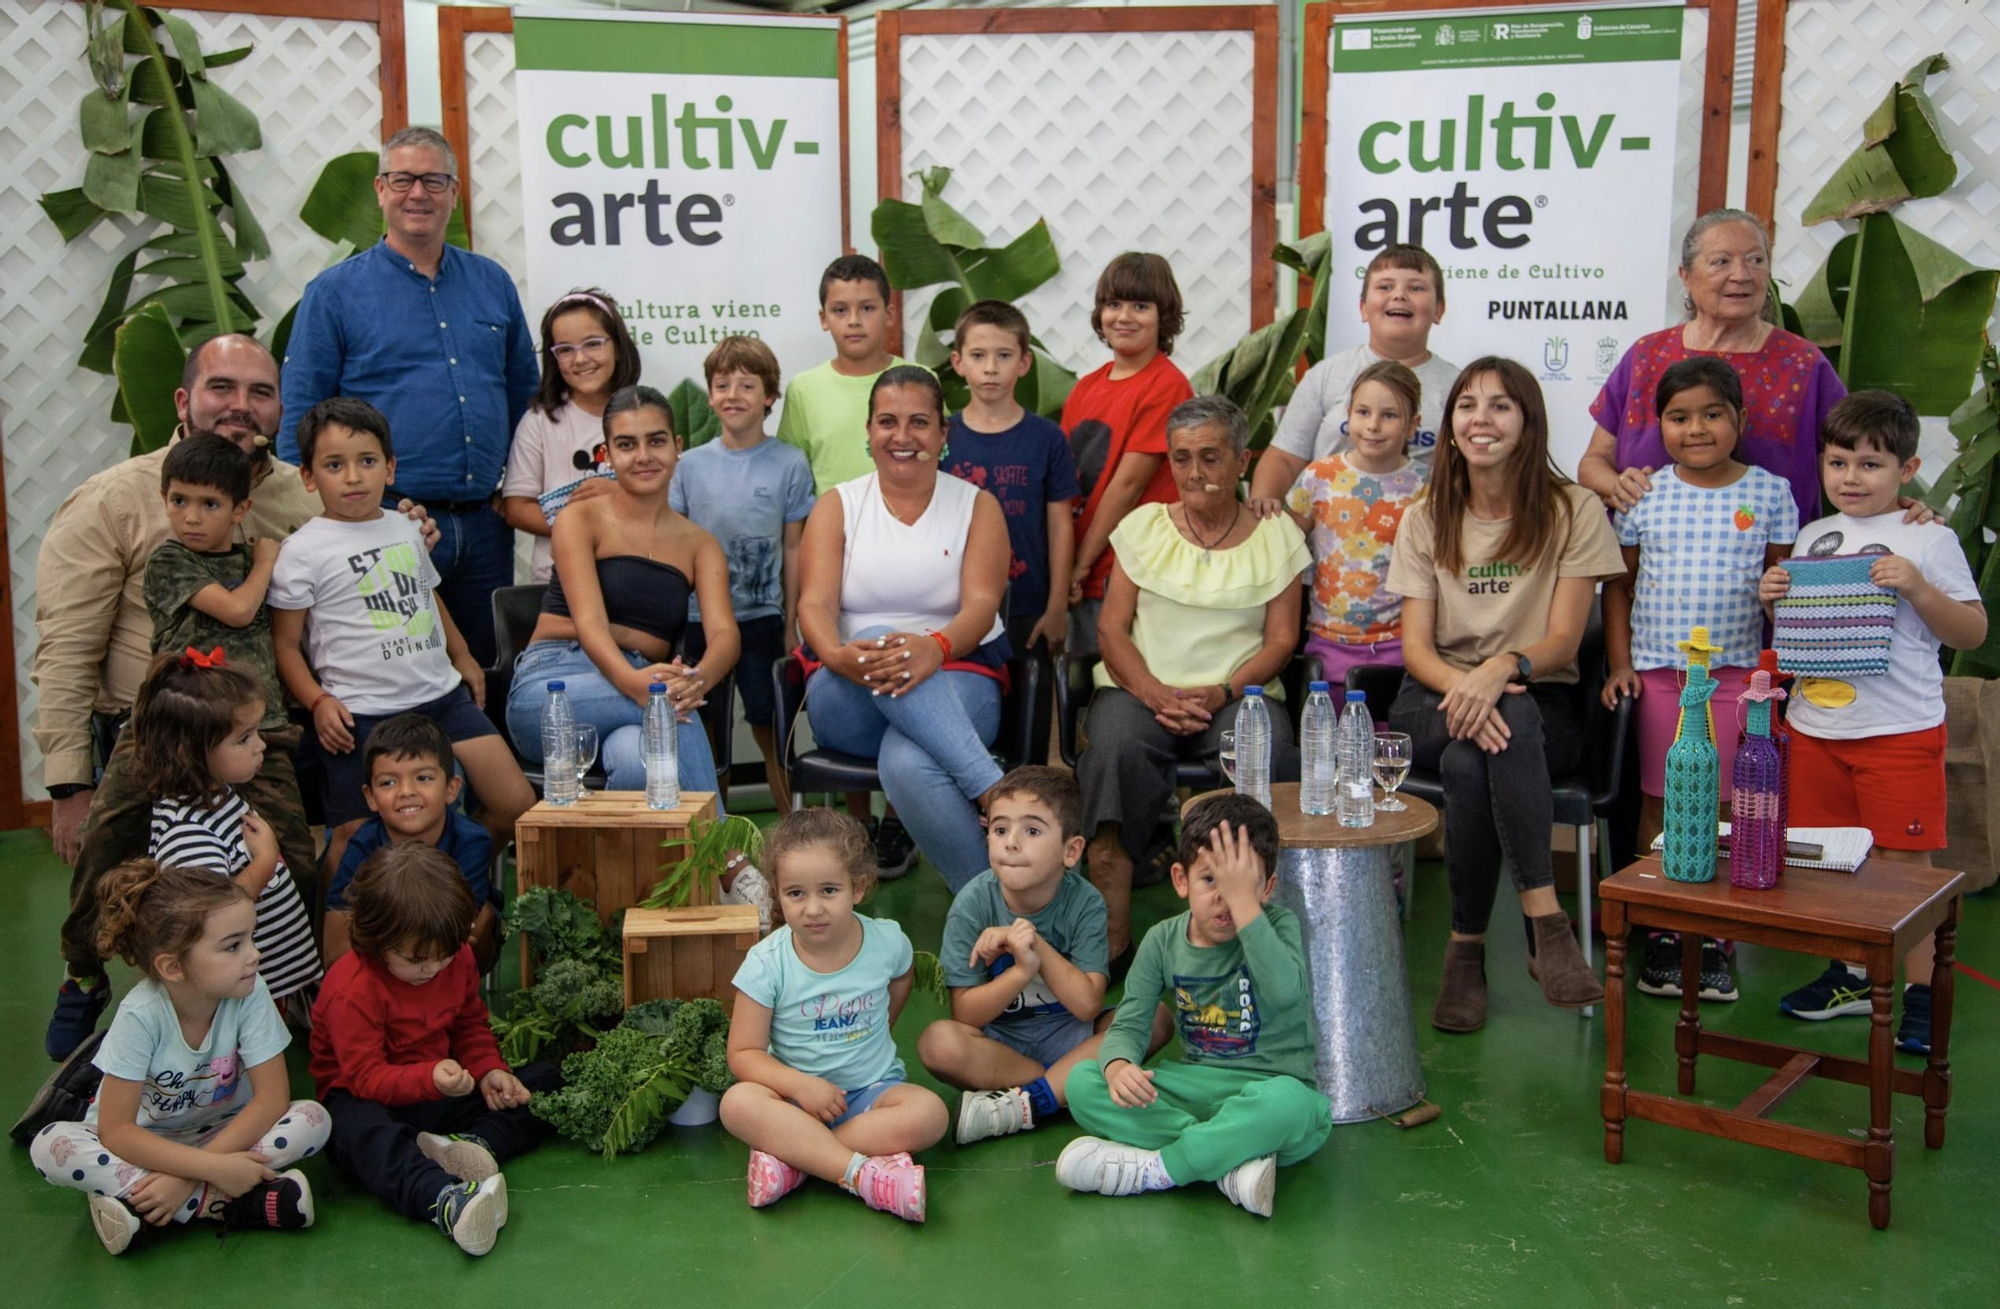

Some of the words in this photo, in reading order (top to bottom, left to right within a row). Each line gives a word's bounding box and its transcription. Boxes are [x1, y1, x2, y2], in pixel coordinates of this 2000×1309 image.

[545, 93, 820, 171] cultiv-
[1358, 92, 1651, 174] cultiv-
[1497, 266, 1520, 279] de
[1529, 264, 1605, 280] Cultivo
[619, 300, 700, 319] ultura
[711, 300, 781, 318] viene
[1488, 300, 1628, 321] PUNTALLANA
[381, 636, 410, 651] START
[383, 640, 432, 661] DOING
[813, 1013, 858, 1031] JEANS
